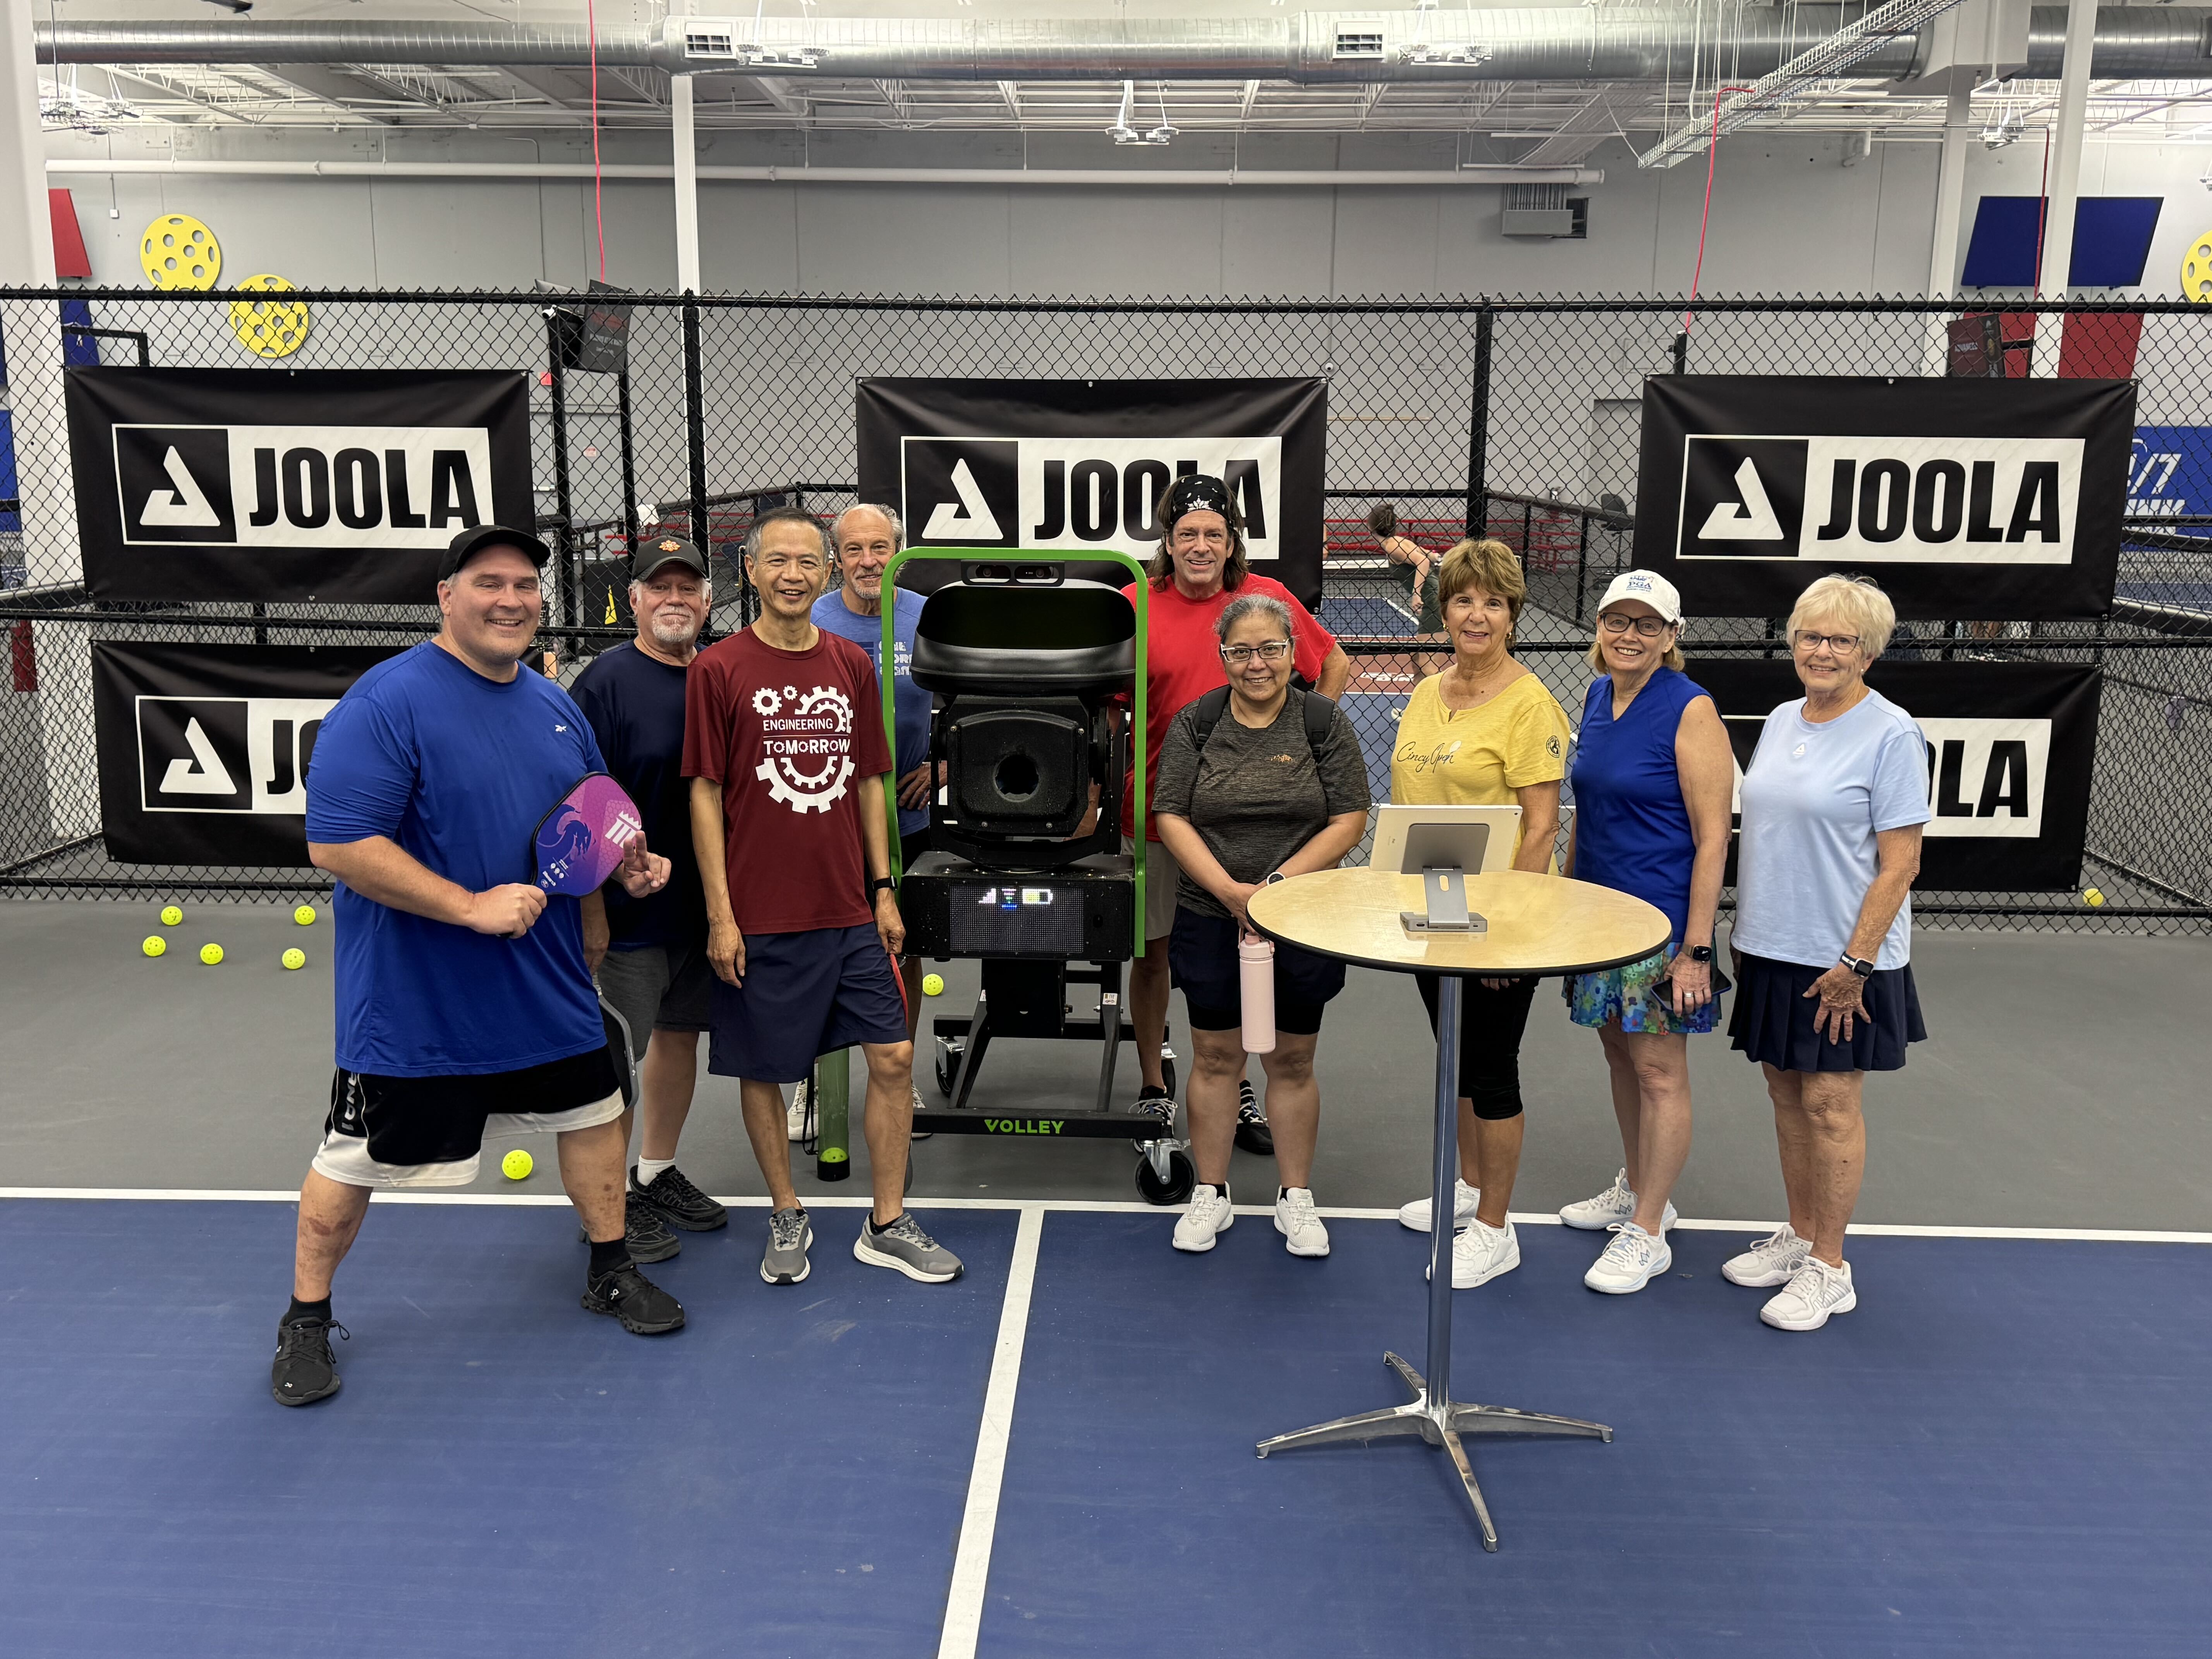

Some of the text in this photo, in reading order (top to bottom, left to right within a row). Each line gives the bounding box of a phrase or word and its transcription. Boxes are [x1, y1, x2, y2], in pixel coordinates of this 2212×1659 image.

[250, 447, 479, 529] JOOLA
[1034, 459, 1267, 541] JOOA
[1817, 459, 2061, 543] JOOLA
[763, 718, 833, 731] ENGINEERING
[763, 739, 850, 755] TOMORROW
[1397, 741, 1455, 773] Cincy Open
[1926, 740, 2029, 817] LA
[984, 1119, 1065, 1134] VOLLEY
